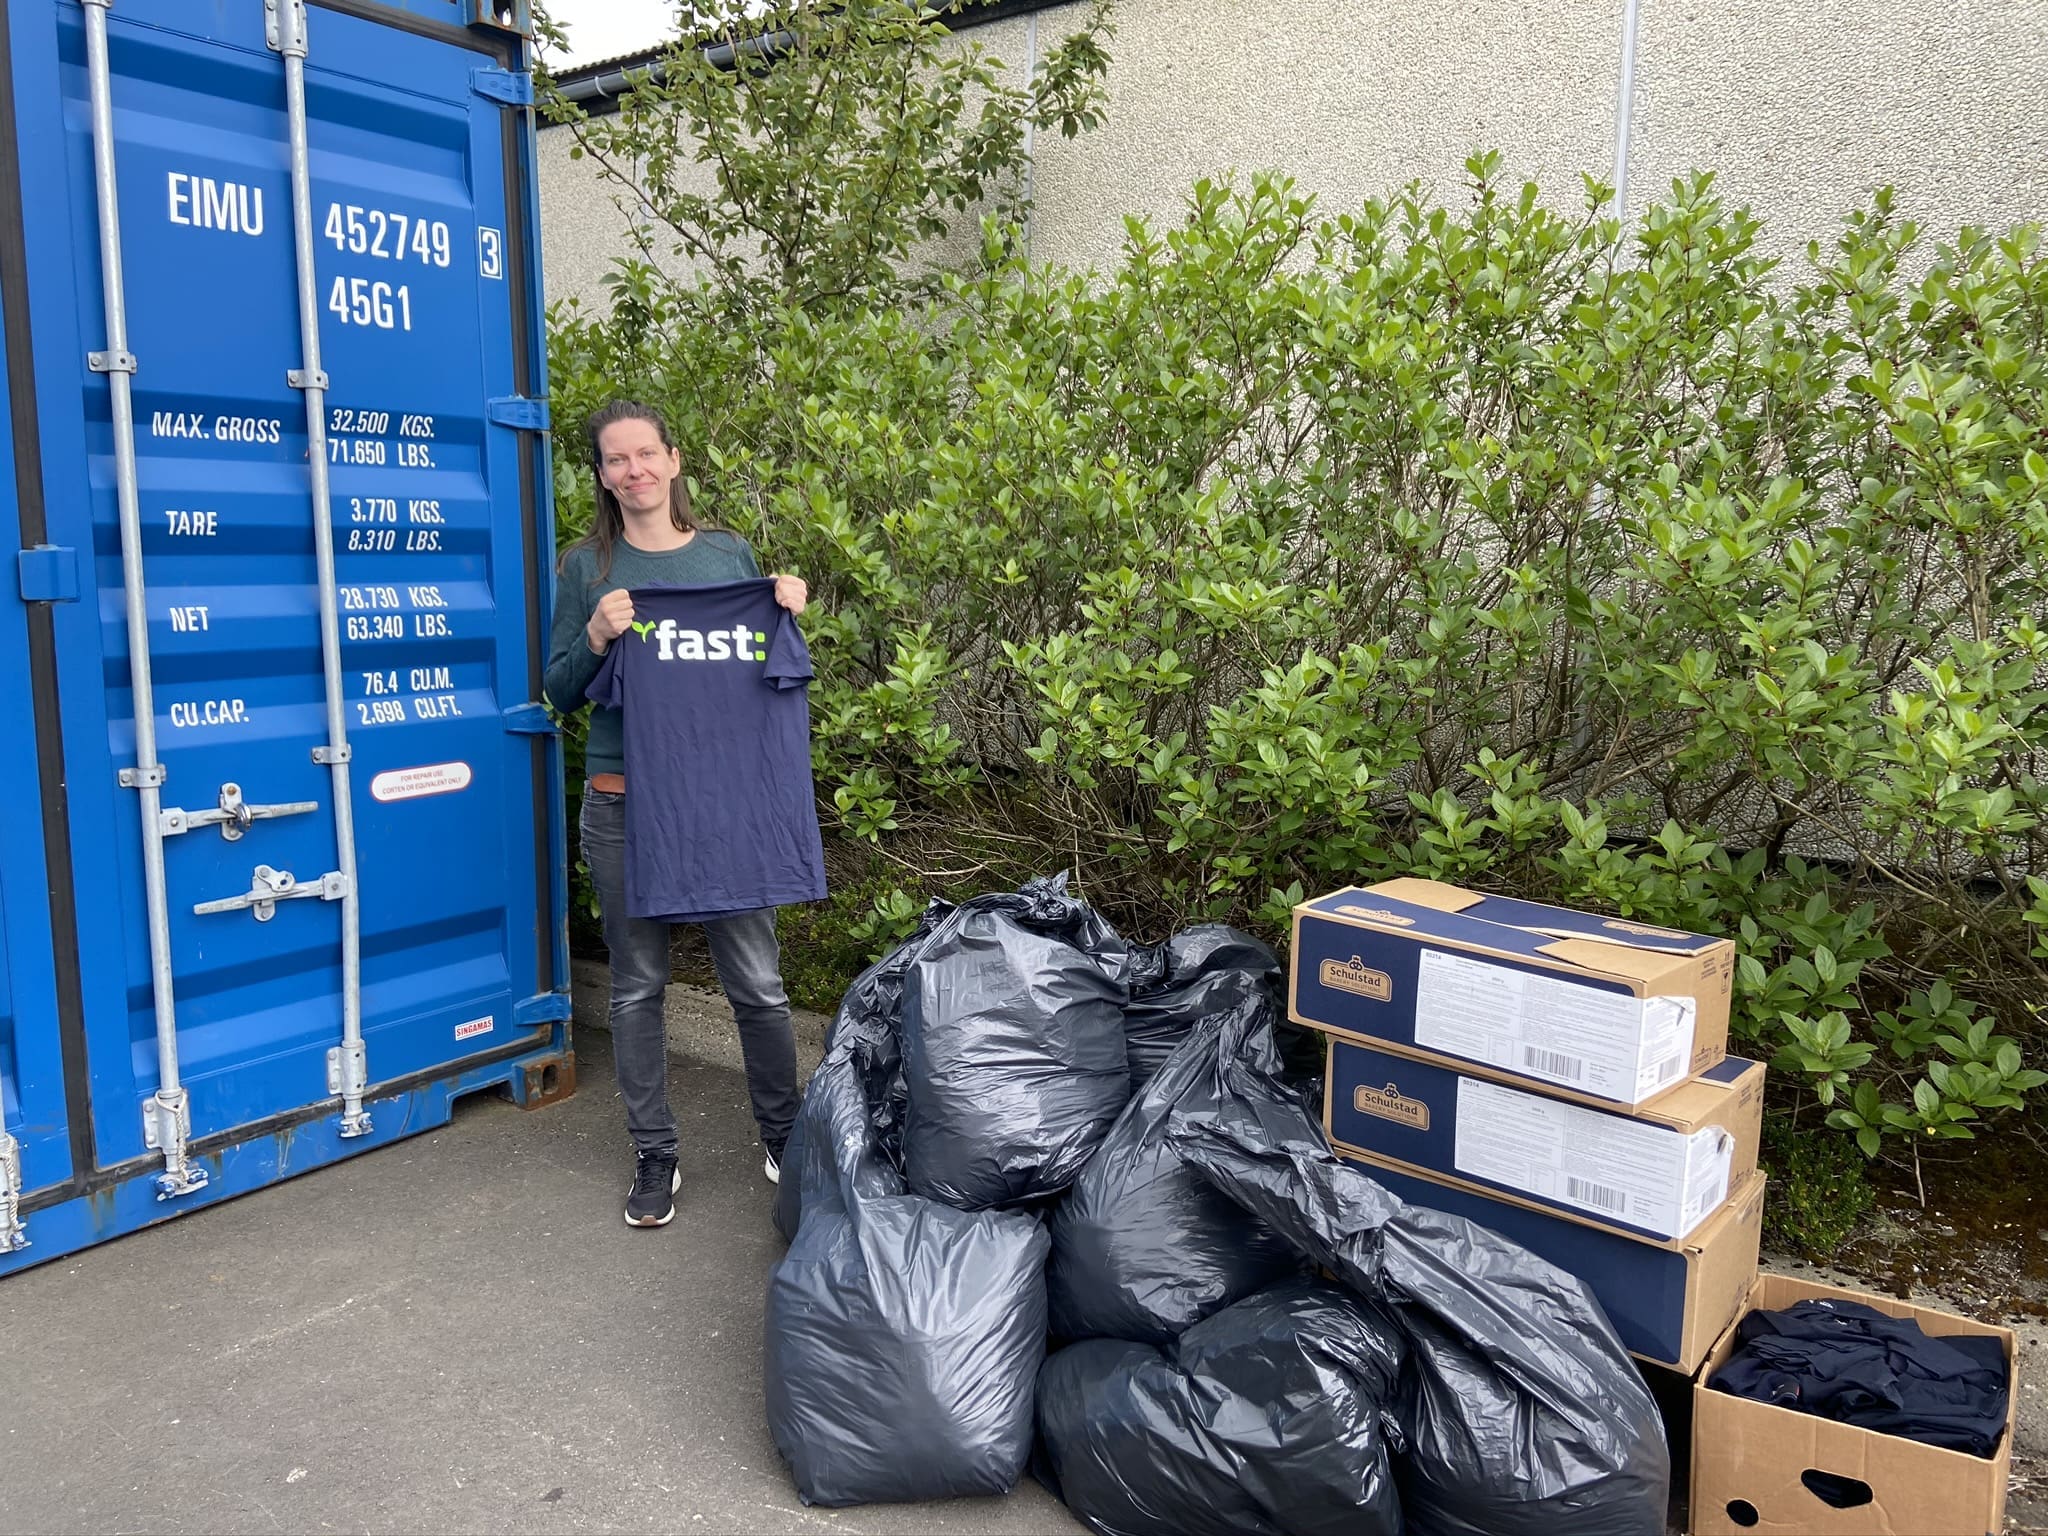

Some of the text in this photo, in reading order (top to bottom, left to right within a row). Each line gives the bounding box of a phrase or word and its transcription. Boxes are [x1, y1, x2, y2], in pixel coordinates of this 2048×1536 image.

[167, 171, 264, 236] EIMU
[324, 202, 500, 275] 452749 3
[328, 276, 412, 331] 45G1
[151, 411, 281, 443] MAX. GROSS
[399, 414, 435, 438] KGS.
[397, 443, 436, 468] LBS.
[165, 510, 218, 536] TARE
[408, 499, 446, 524] KGS.
[405, 529, 443, 551] LBS.
[408, 585, 449, 608] KGS.
[169, 606, 209, 632] NET
[415, 613, 452, 638] LBS.
[362, 667, 454, 696] 76.4 CU.M.
[170, 699, 250, 728] CU.CAP.
[1330, 966, 1381, 987] Schulstad
[456, 1019, 492, 1037] SINGAMAS
[1364, 1092, 1419, 1116] Schulstad
